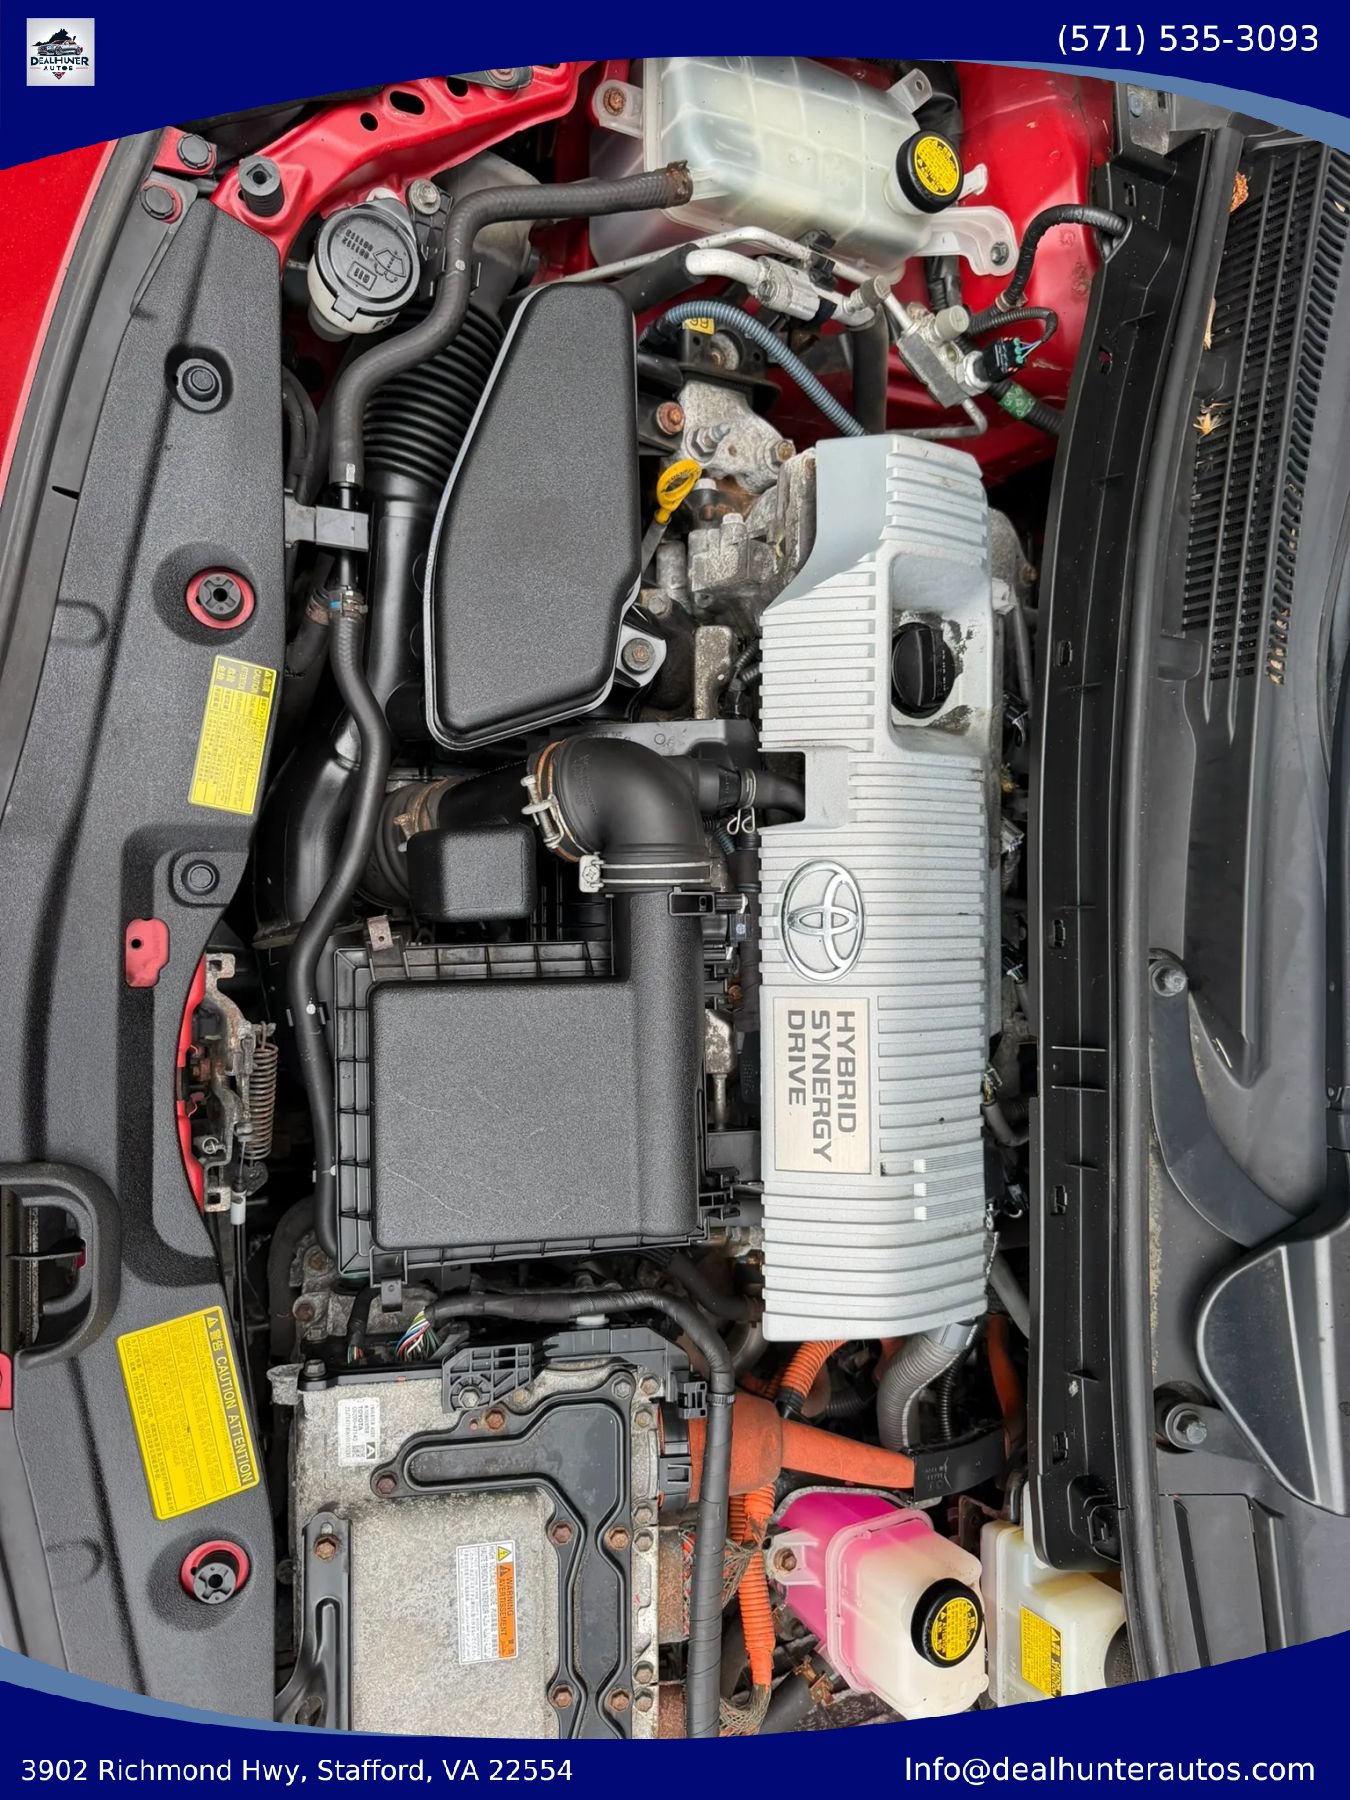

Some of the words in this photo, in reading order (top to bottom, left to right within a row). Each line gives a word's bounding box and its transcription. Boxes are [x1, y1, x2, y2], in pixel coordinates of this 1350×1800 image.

[787, 1010, 806, 1106] DRIVE
[811, 1010, 832, 1163] SYNERGY
[836, 1011, 857, 1133] HYBRID
[214, 1355, 237, 1410] CAUTION
[227, 1412, 253, 1483] ATTENTION
[367, 1444, 374, 1456] A
[497, 1577, 508, 1636] AVERTISSEMENT
[505, 1577, 514, 1616] WARNING
